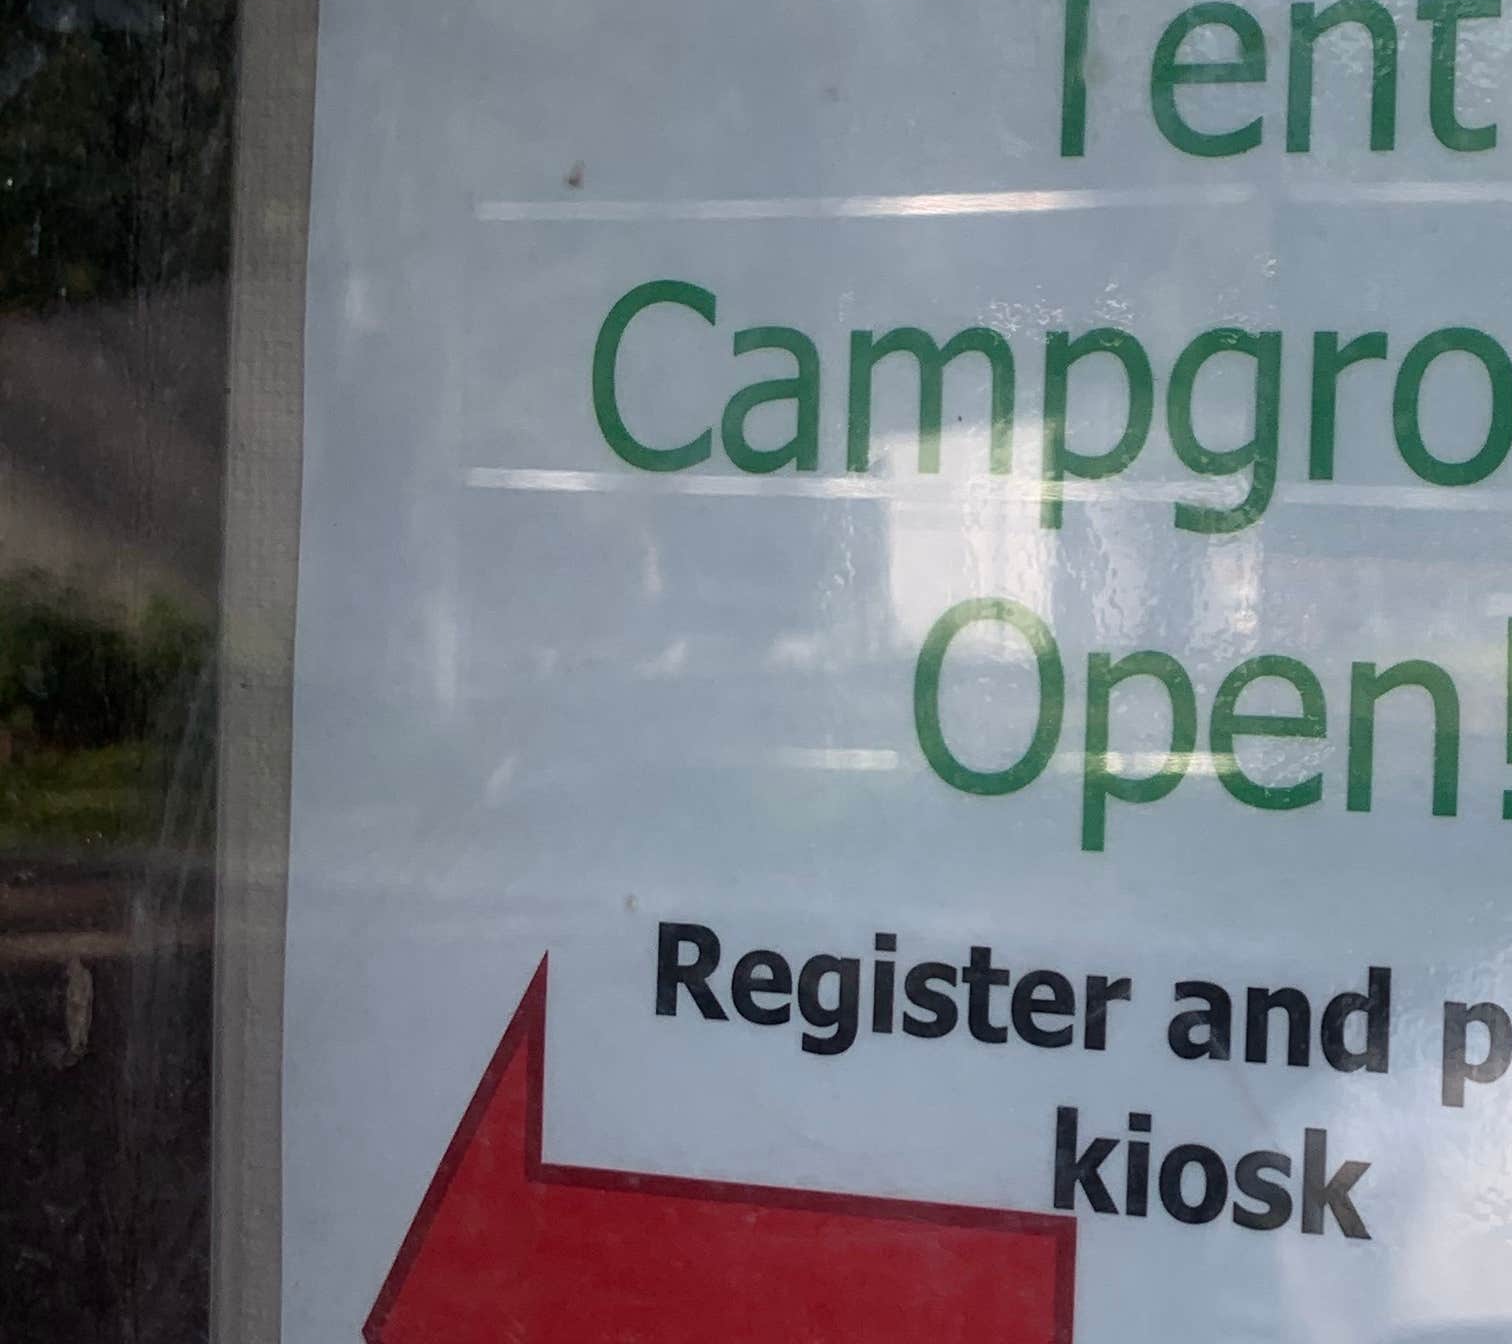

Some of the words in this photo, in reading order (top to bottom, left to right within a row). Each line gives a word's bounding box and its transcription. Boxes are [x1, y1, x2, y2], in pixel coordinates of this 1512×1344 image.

[655, 920, 1132, 1056] Register
[1166, 966, 1392, 1075] and
[1051, 1106, 1373, 1241] kiosk
